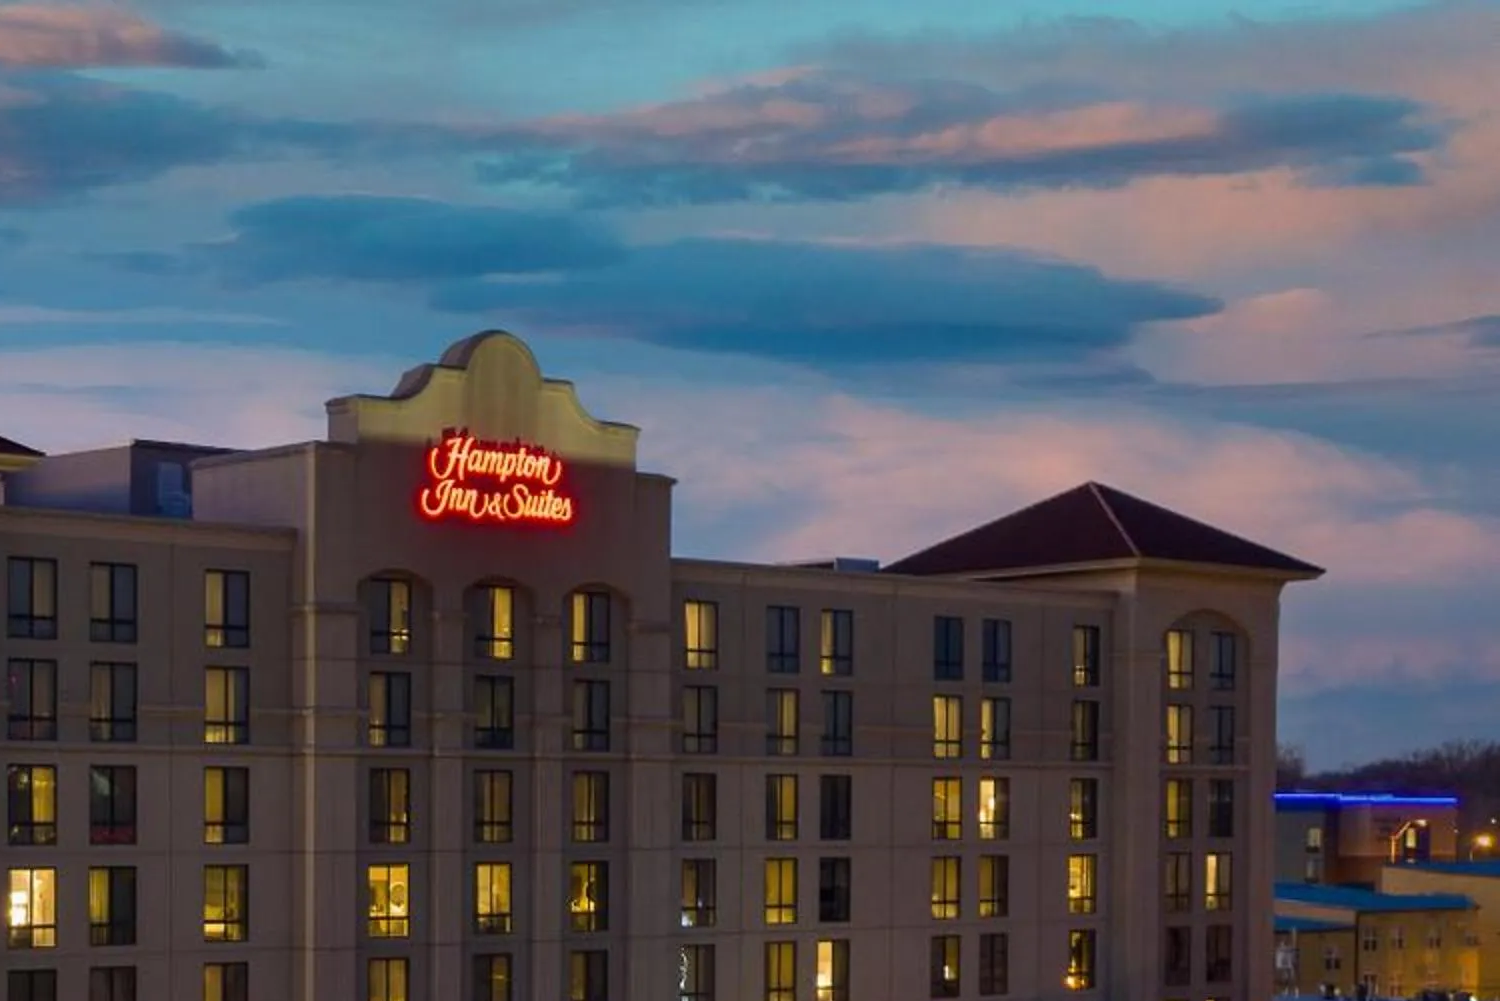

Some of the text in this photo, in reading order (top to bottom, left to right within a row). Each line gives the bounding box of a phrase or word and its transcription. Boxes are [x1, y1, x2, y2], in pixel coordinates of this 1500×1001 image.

[431, 436, 562, 485] Hampton
[421, 479, 573, 521] Inn & Suites
